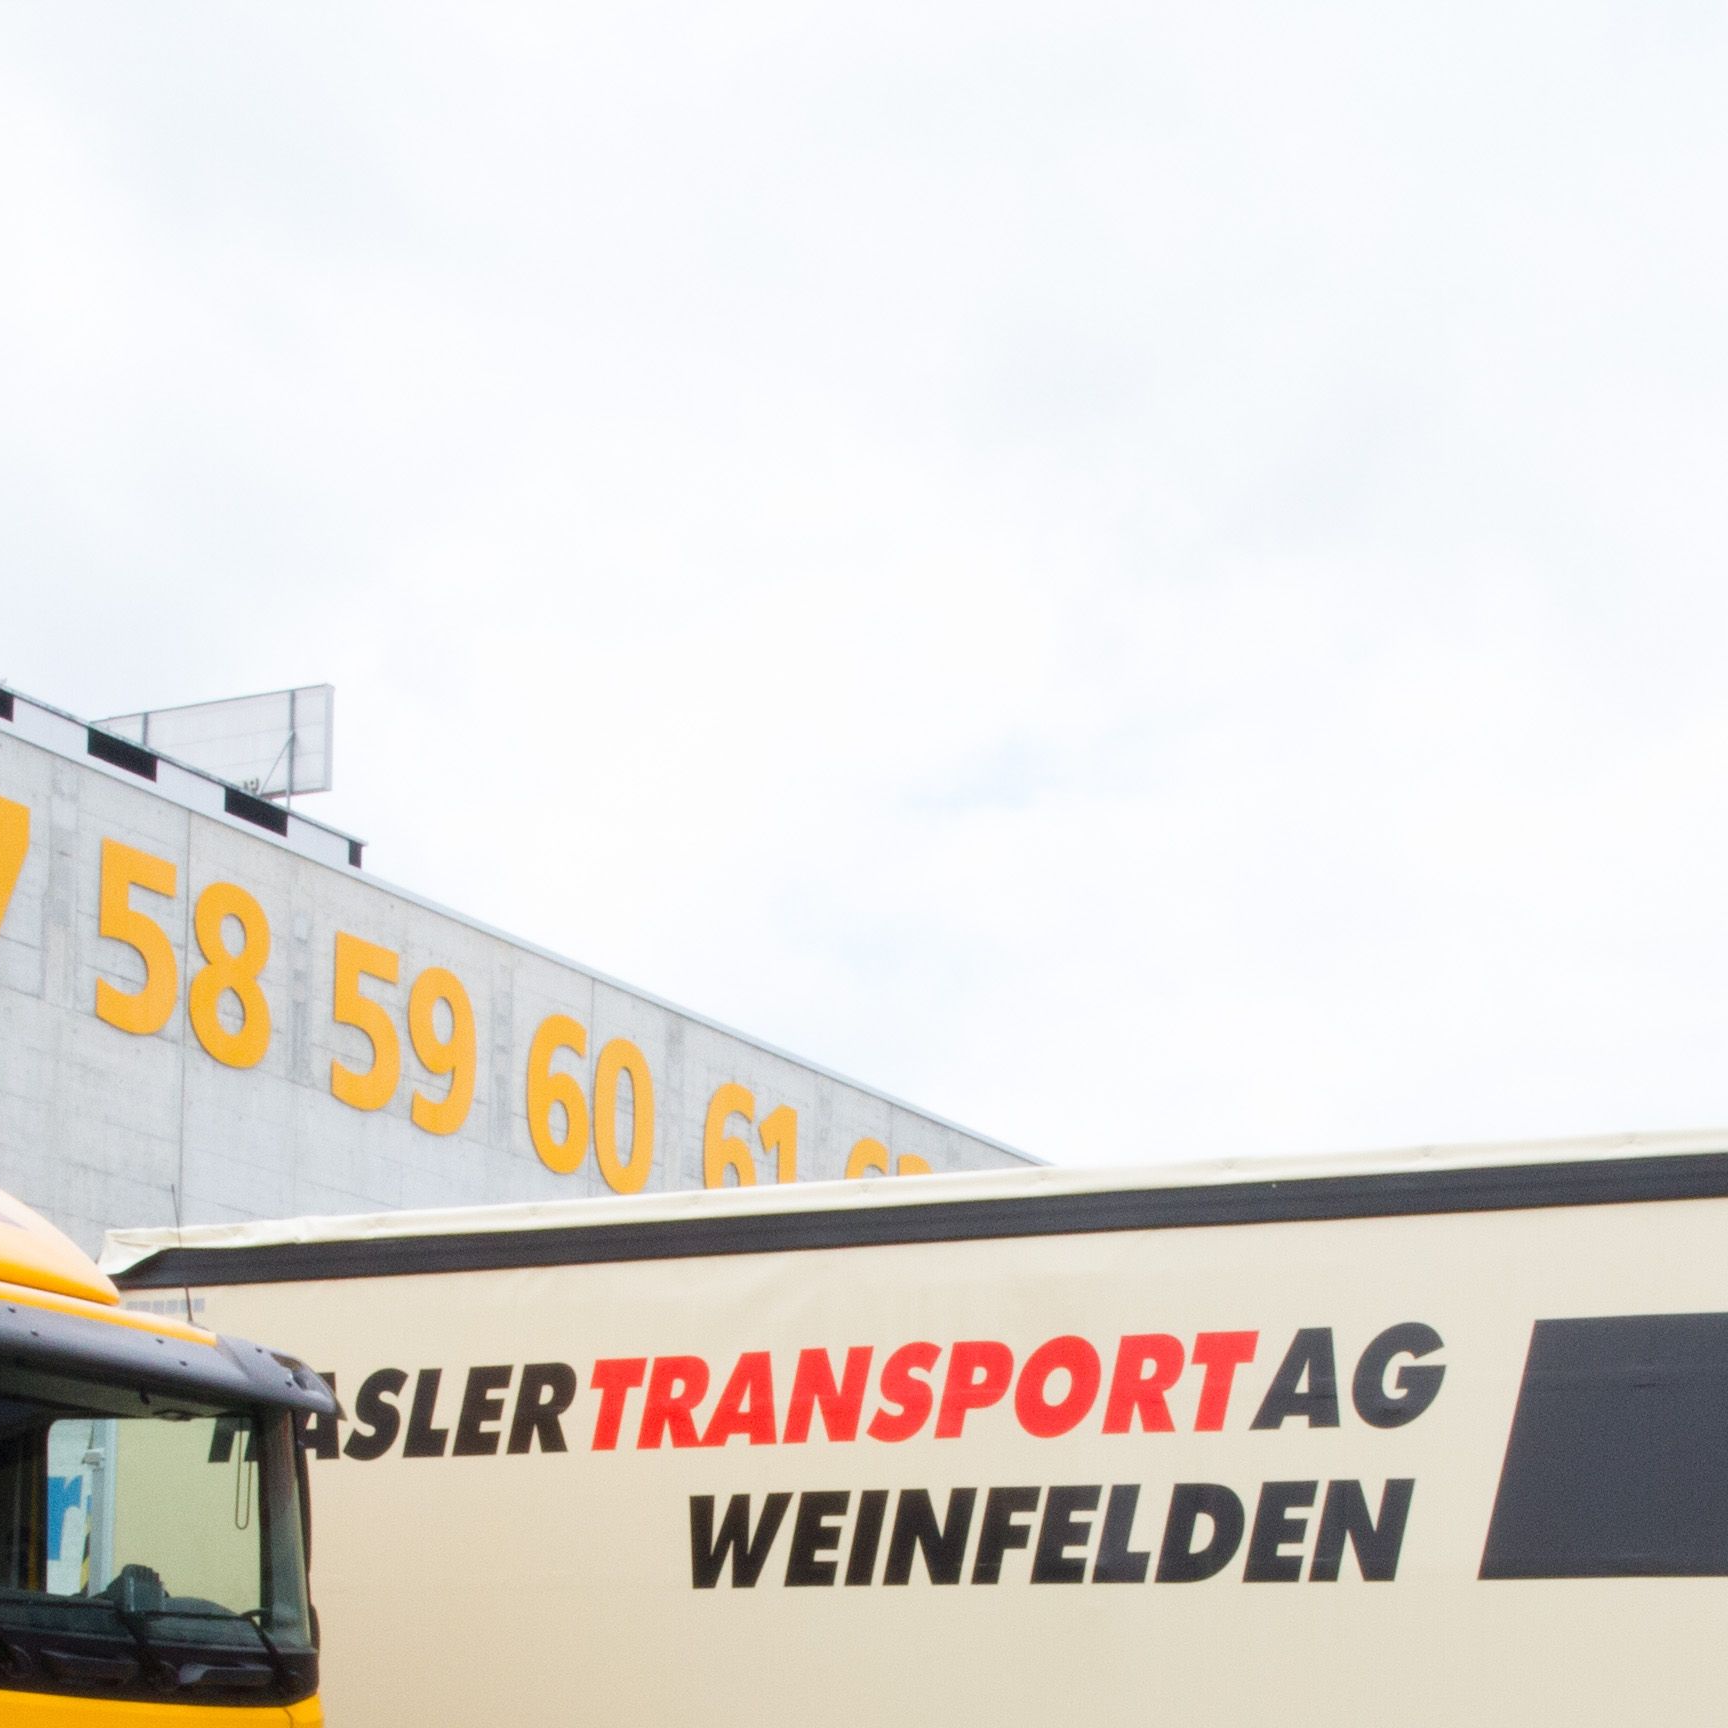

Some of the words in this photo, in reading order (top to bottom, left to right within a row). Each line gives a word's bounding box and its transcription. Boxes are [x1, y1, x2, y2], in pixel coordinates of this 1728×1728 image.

[96, 838, 271, 1068] 58
[331, 931, 476, 1135] 59
[527, 1014, 654, 1194] 60
[590, 1330, 1259, 1451] TRANSPORT
[1249, 1322, 1446, 1430] AG
[689, 1478, 1415, 1589] WEINFELDEN
